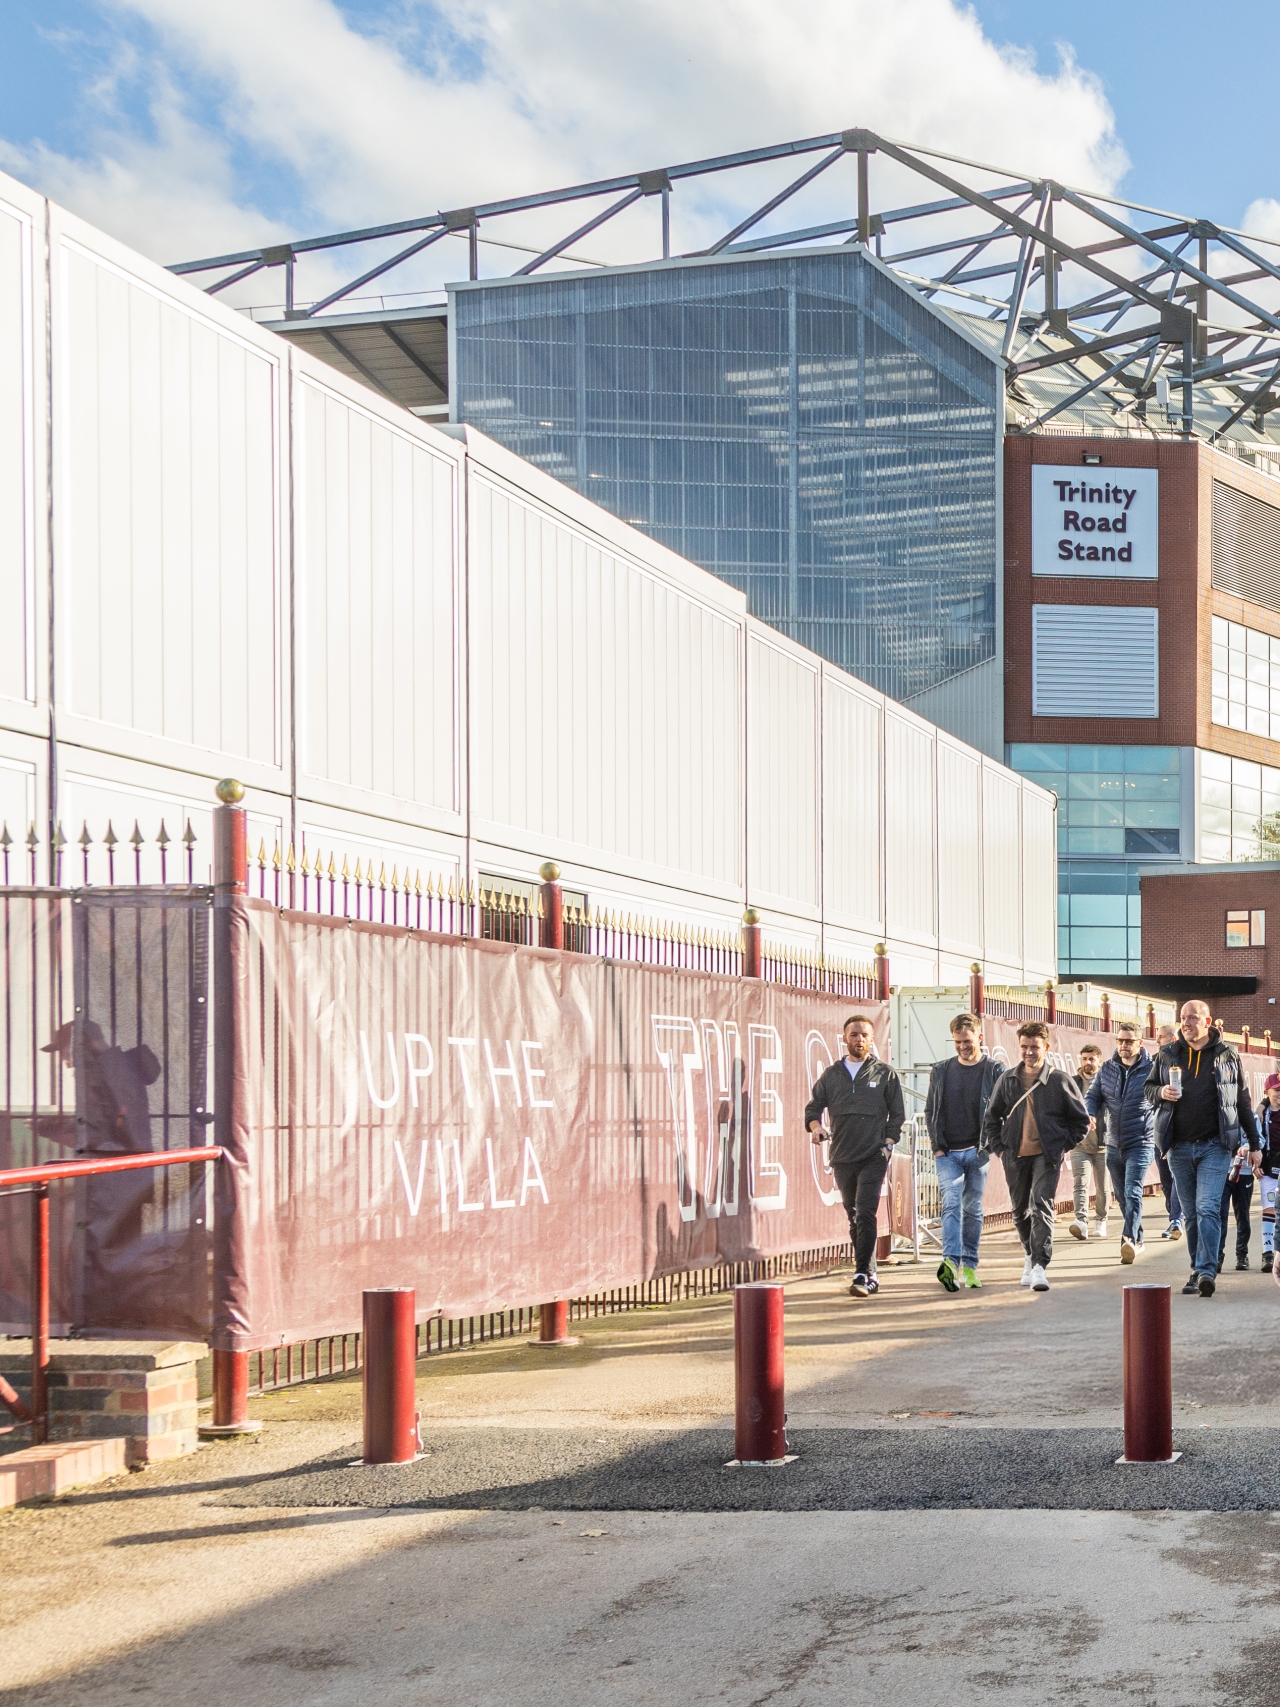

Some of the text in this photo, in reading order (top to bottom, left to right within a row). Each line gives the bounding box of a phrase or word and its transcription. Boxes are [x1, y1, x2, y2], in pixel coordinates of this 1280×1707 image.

[1053, 480, 1137, 510] Trinity
[1064, 510, 1127, 533] Road
[1058, 539, 1133, 562] Stand
[359, 1030, 554, 1109] UP THE
[651, 1014, 787, 1222] THE
[394, 1136, 549, 1217] VILLA
